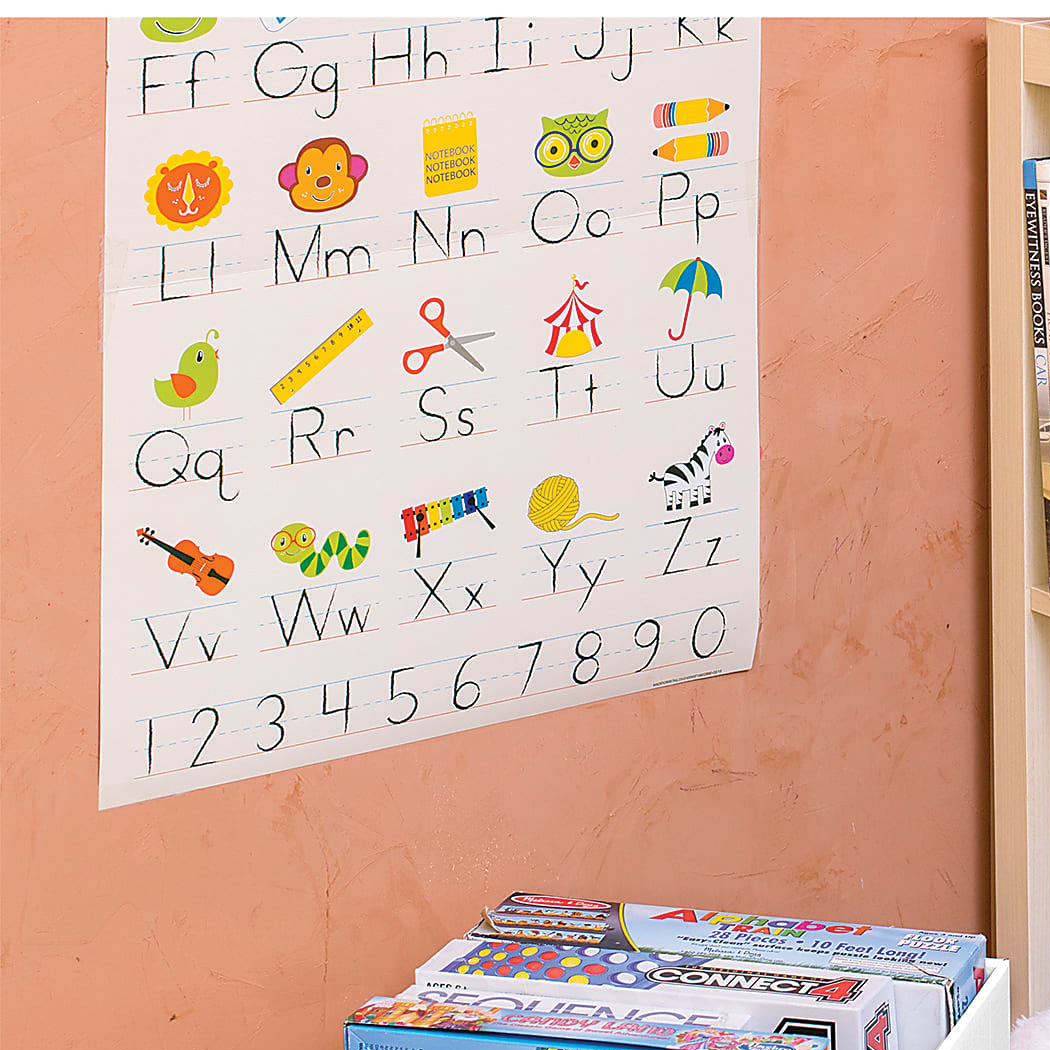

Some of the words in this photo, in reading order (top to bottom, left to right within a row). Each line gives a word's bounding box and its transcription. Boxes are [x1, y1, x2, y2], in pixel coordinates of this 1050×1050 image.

[142, 51, 215, 114] Ff
[254, 41, 339, 118] Gg
[371, 26, 447, 86] Hh
[425, 144, 475, 161] NOTEBOOK
[426, 156, 476, 173] NOTEBOOK
[426, 167, 477, 184] NOTEBOOK
[275, 224, 371, 284] Mm
[412, 206, 486, 264] Nn
[531, 189, 611, 244] Oo
[658, 172, 719, 244] Pp
[1025, 193, 1041, 288] EYEWITNESS
[1031, 290, 1046, 345] BOOKS
[1036, 354, 1047, 387] CAR
[135, 429, 240, 501] Qq
[290, 406, 354, 464] Rr
[418, 386, 474, 442] Ss
[539, 365, 598, 419] Tt
[655, 343, 727, 399] Uu
[144, 612, 222, 670] Vv
[271, 585, 371, 648] Ww
[413, 562, 484, 621] Xx
[538, 540, 607, 613] Yy
[663, 517, 722, 576] Zz
[189, 707, 220, 769] 2
[256, 694, 286, 752] 3
[322, 680, 352, 734] 4
[387, 667, 418, 725] 5
[452, 654, 482, 711] 6
[518, 641, 544, 696] 7
[572, 631, 602, 685] 8
[634, 619, 661, 673] 9
[649, 908, 872, 937] Alphabet
[718, 923, 806, 938] TRAIN
[708, 930, 733, 940] 28
[734, 932, 788, 945] Pieces
[812, 940, 833, 950] 10
[876, 946, 927, 959] Long!
[753, 943, 794, 951] surface
[796, 946, 829, 955] keeps
[832, 951, 870, 960] puzzle
[897, 940, 961, 953] PUZZLE
[903, 933, 959, 945] FLOOR
[652, 968, 819, 994] CONNECT
[501, 1013, 598, 1028] CANDY
[601, 1020, 676, 1036] LAND
